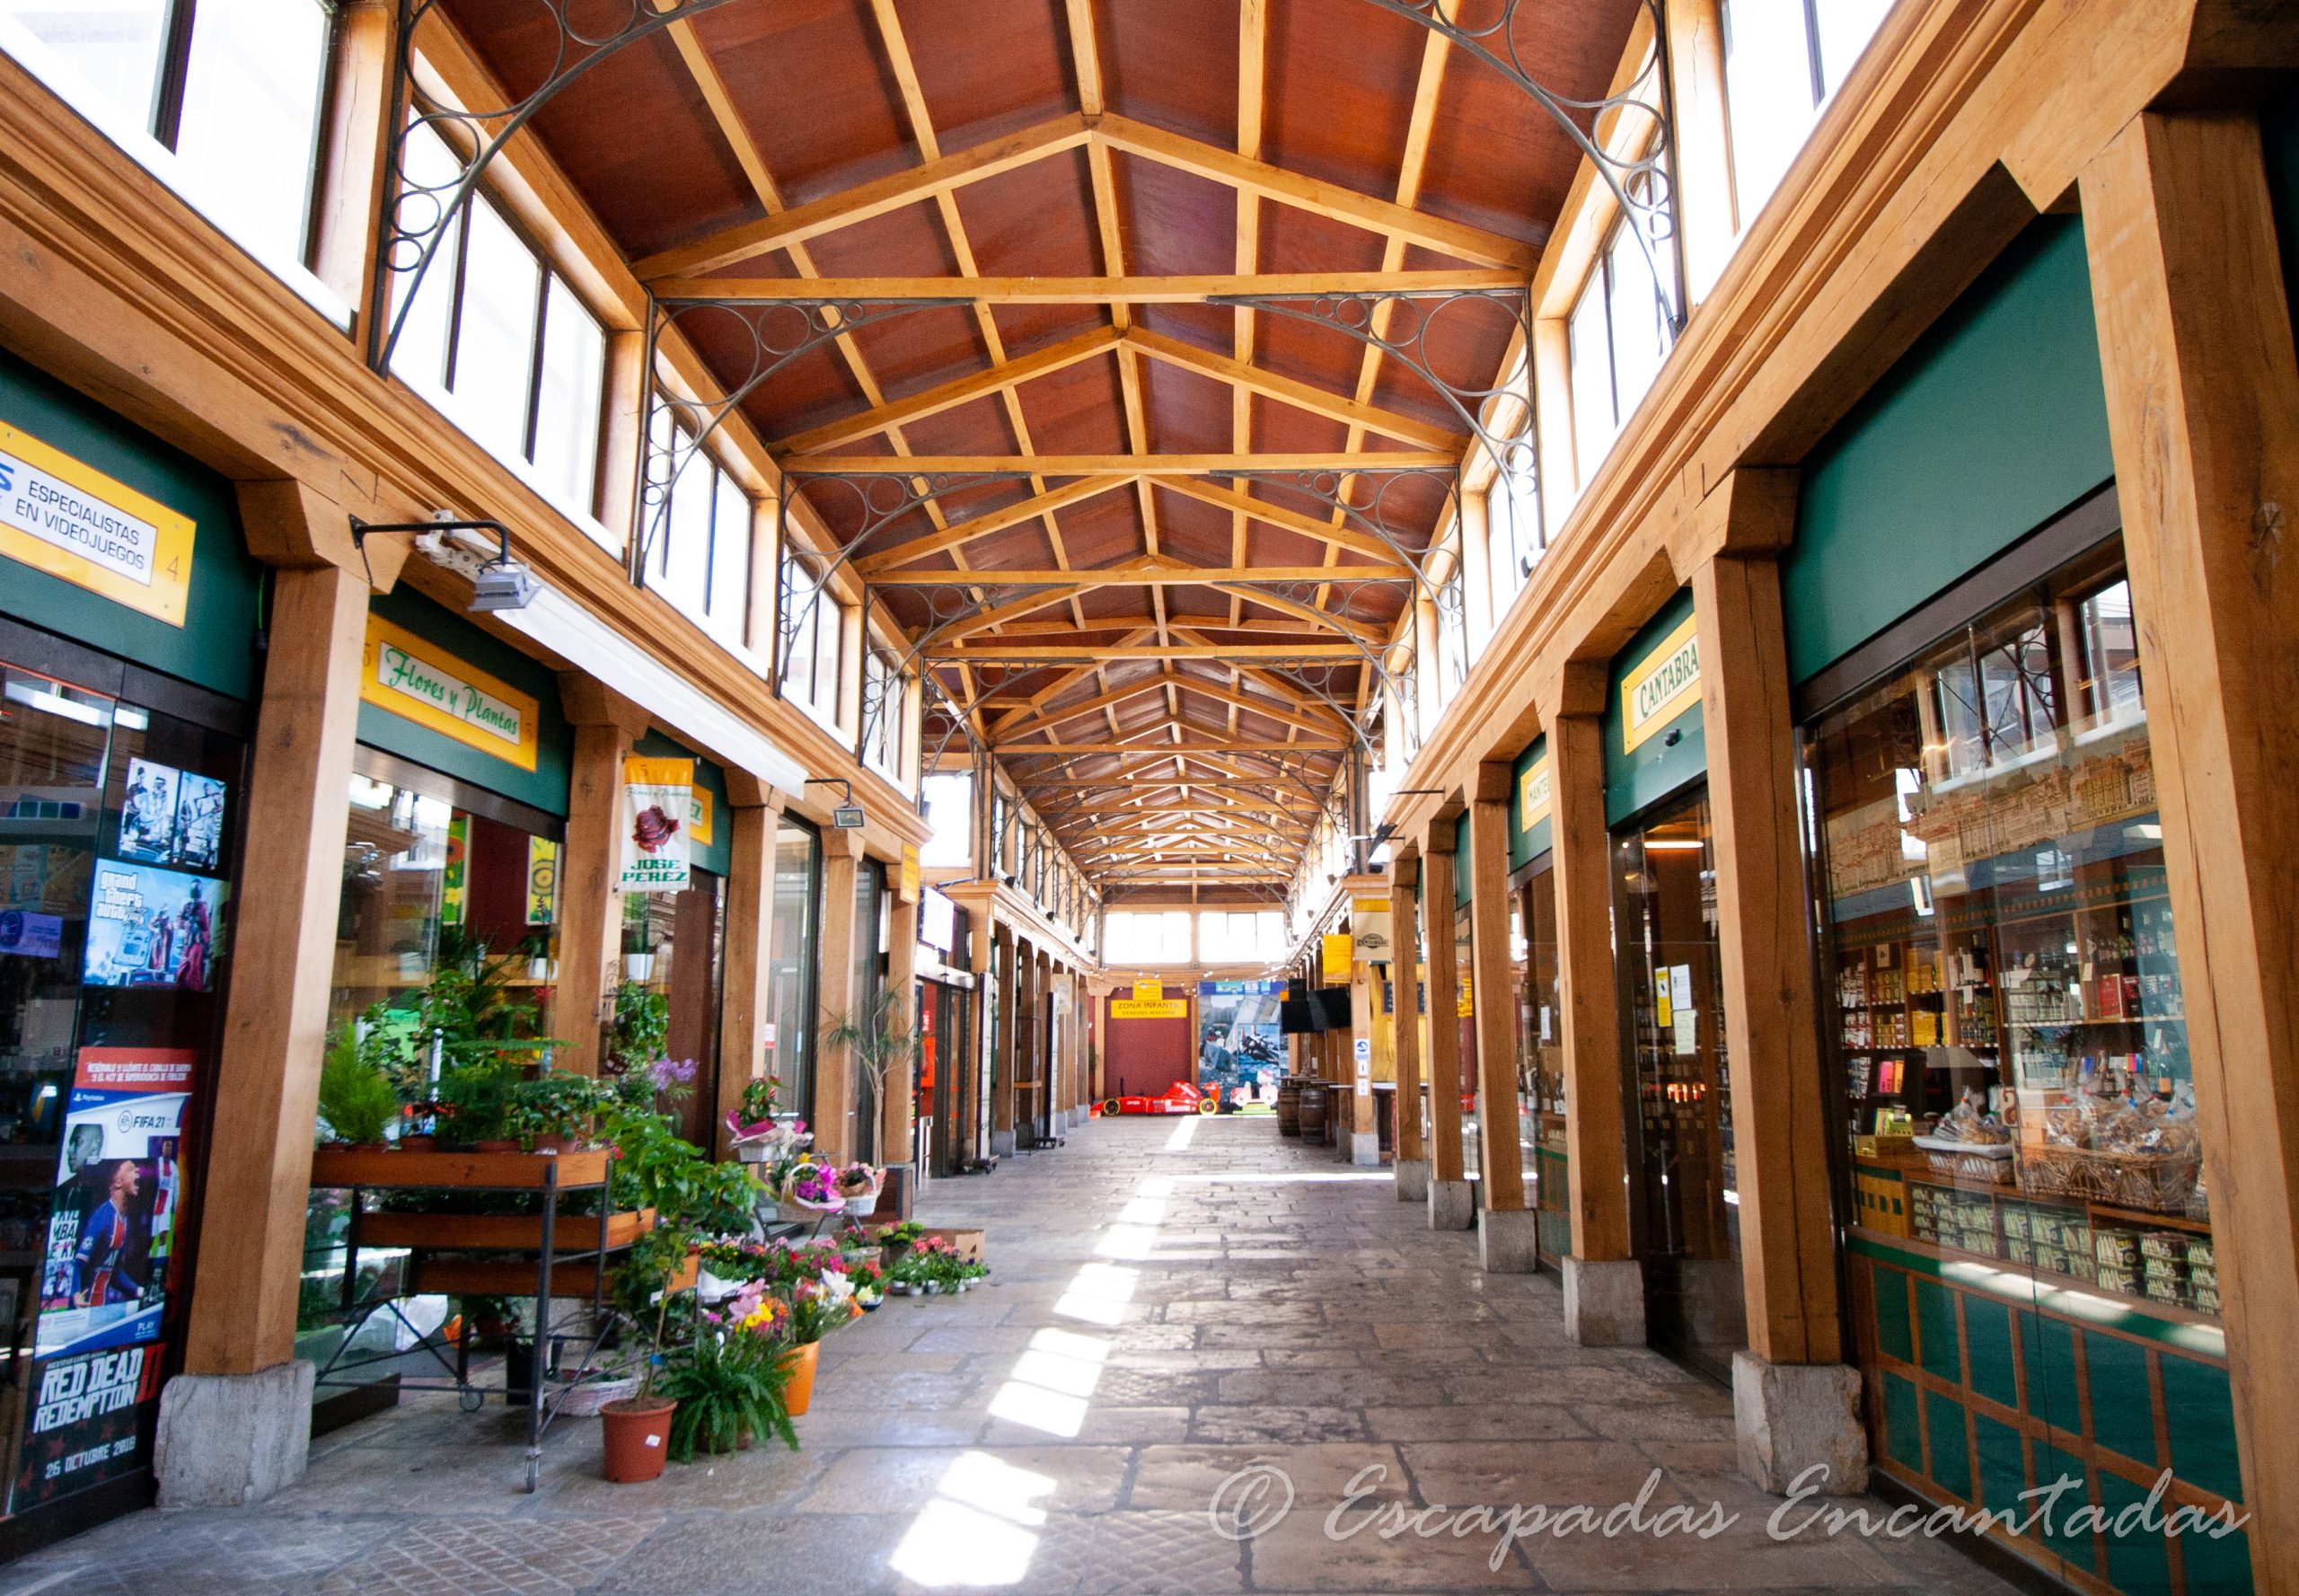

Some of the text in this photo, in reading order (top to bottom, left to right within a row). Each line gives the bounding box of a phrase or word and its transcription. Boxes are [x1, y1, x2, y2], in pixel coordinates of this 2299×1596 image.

[15, 498, 145, 570] EN VIDEOJUEGOS
[29, 480, 140, 546] ESPECIALISTAS
[166, 555, 180, 582] 4
[384, 648, 518, 736] Flores y Plantas
[1641, 643, 1699, 719] CANTABRA
[621, 871, 688, 883] PEREZ
[630, 859, 681, 870] JOSE
[1117, 1001, 1181, 1010] ZONA INFANTIL
[134, 1116, 154, 1129] FIFA
[154, 1116, 165, 1129] 21
[40, 1347, 145, 1406] RED DEAD
[33, 1380, 138, 1433] REDEMPTION
[45, 1459, 61, 1479] 26
[65, 1443, 110, 1474] OCTUBRE
